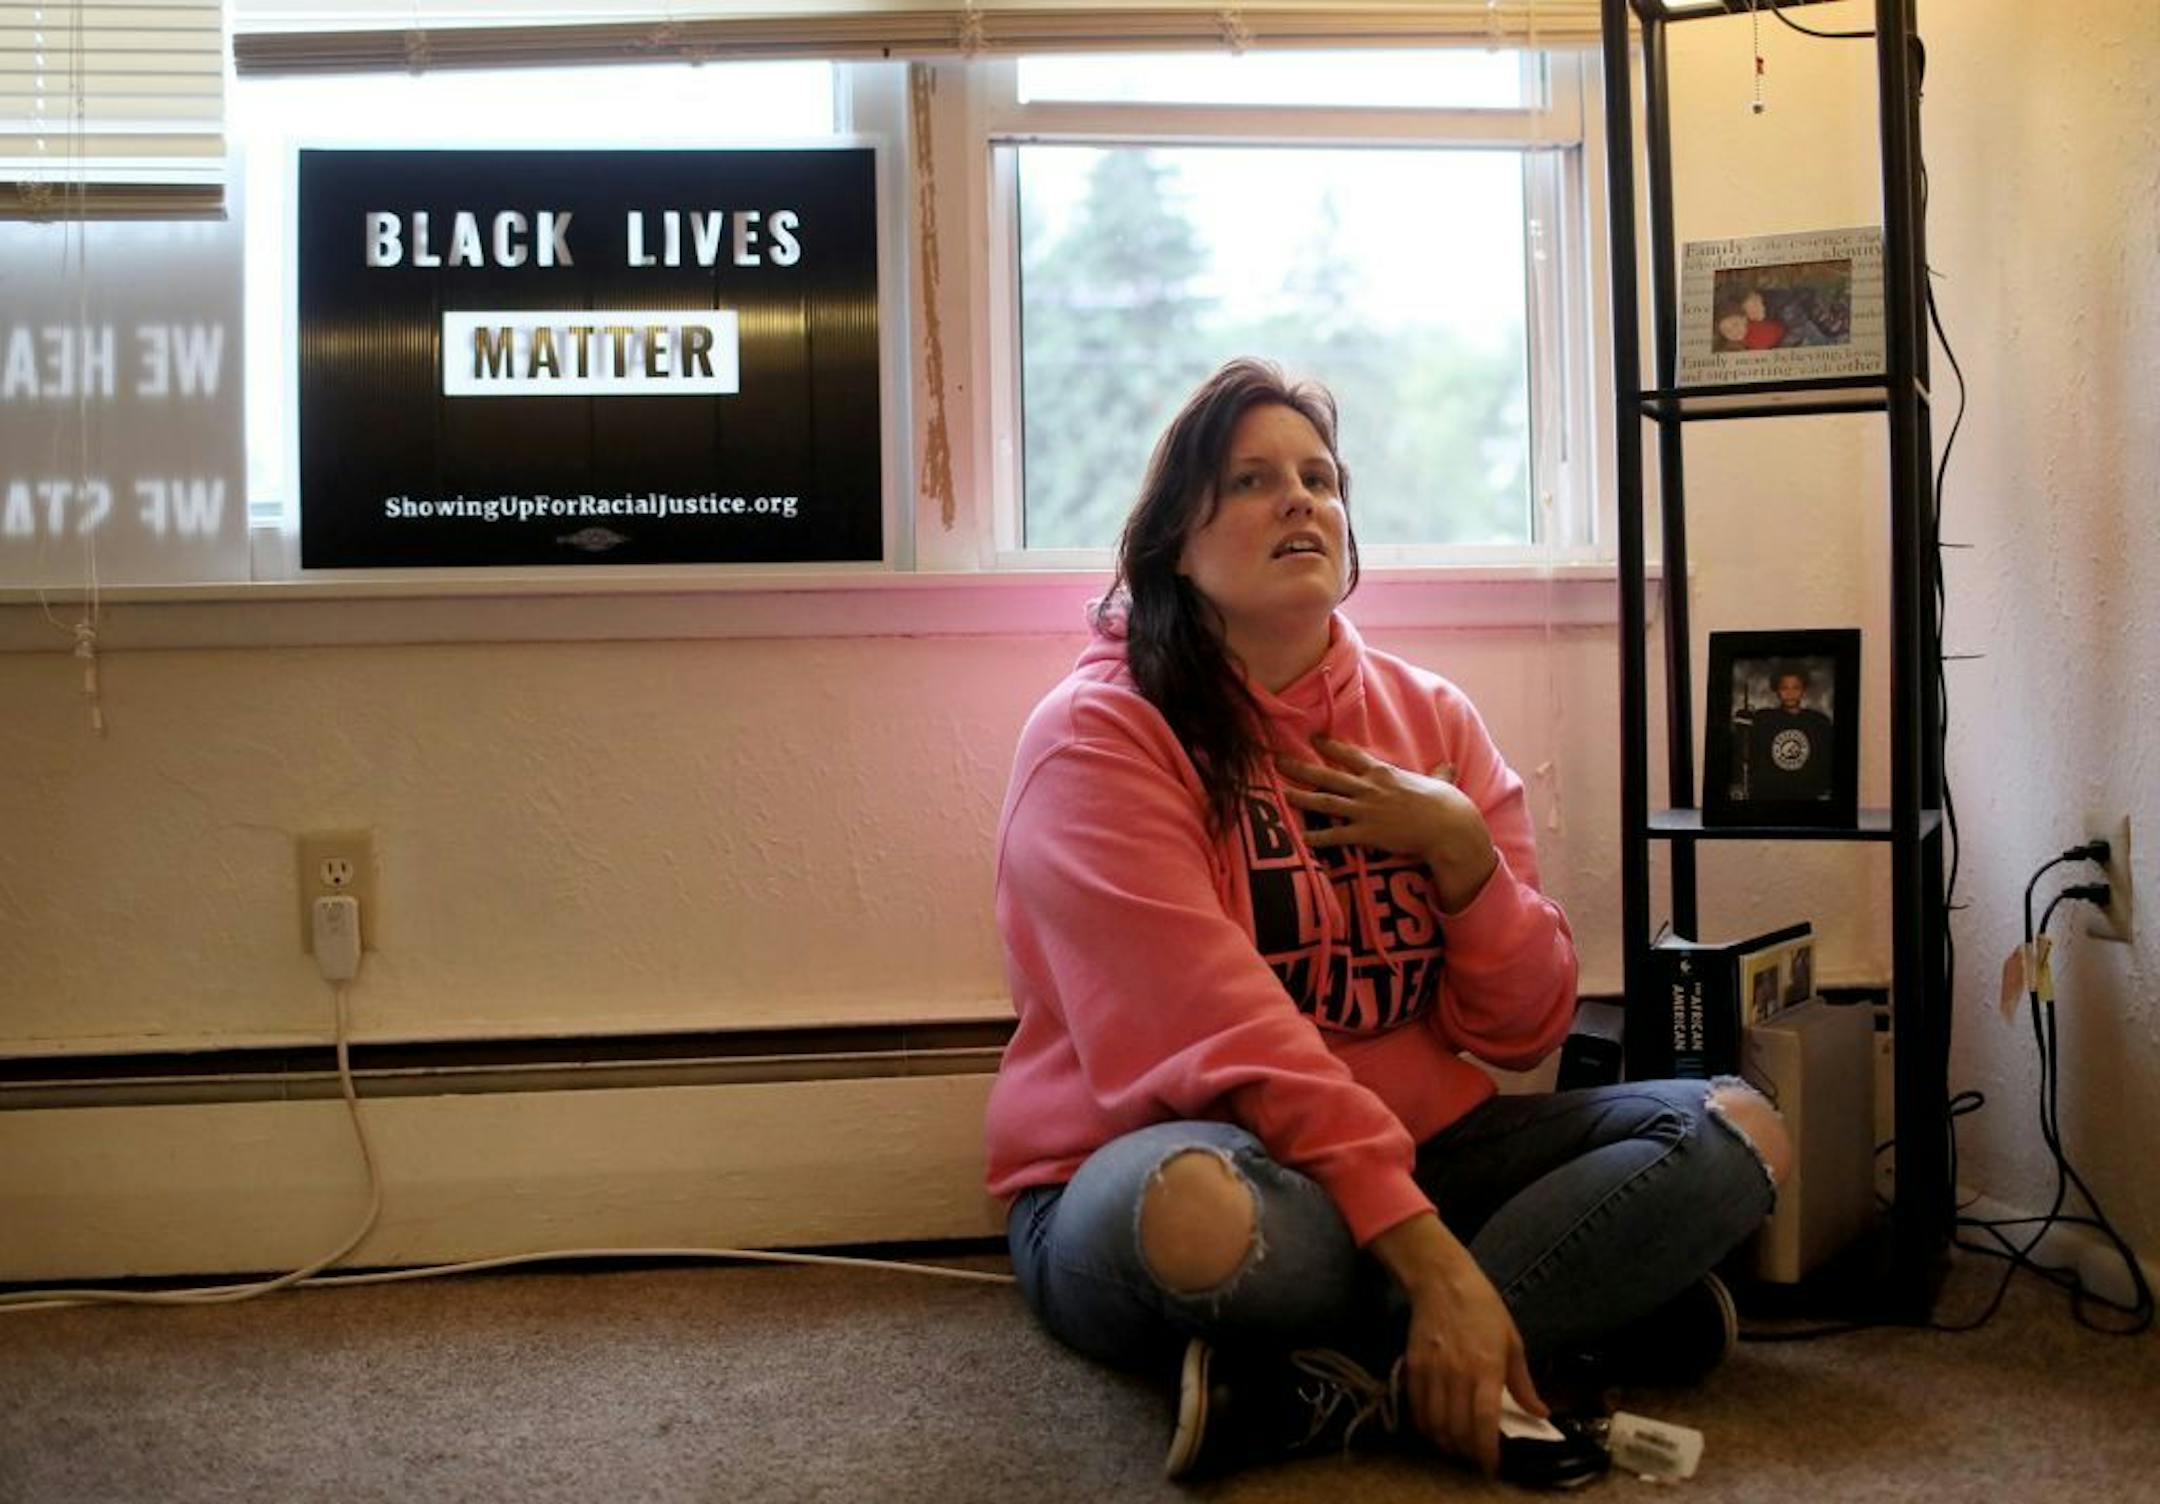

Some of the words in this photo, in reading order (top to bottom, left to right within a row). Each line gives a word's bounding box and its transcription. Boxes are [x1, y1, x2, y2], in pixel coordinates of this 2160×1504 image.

[366, 211, 575, 267] BLACK
[627, 210, 802, 266] LIVES
[1685, 239, 1743, 257] Family
[473, 325, 716, 380] MATTER
[385, 492, 799, 521] ShowingUpForRacialJustice.org
[1672, 984, 1687, 1051] AMERICAN
[1690, 995, 1704, 1051] AFRICAN
